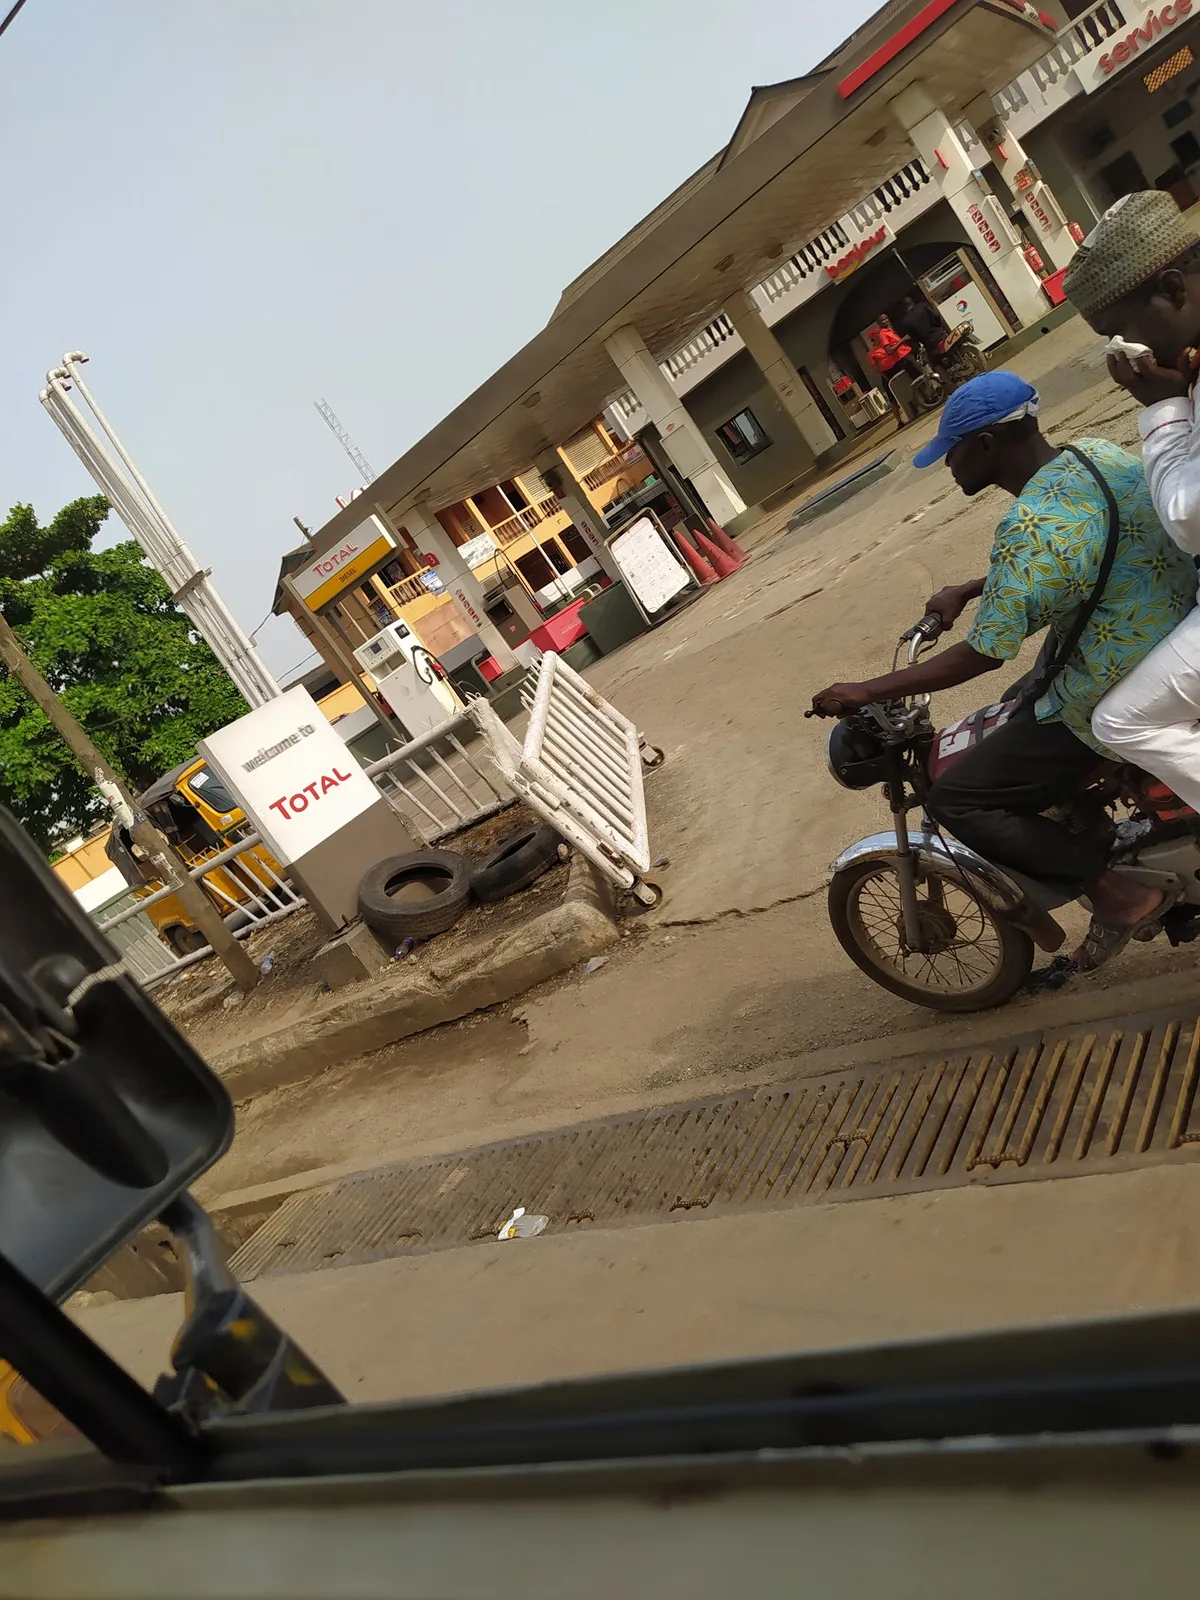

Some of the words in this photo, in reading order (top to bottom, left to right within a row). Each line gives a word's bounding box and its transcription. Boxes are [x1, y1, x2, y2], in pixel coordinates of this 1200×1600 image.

[1099, 0, 1192, 73] service
[824, 225, 887, 278] bonjour
[312, 543, 359, 577] TOTAL
[338, 567, 357, 583] DIESEL
[428, 555, 436, 565] 3
[241, 732, 301, 773] welcome
[298, 723, 316, 738] to
[269, 768, 352, 820] TOTAL
